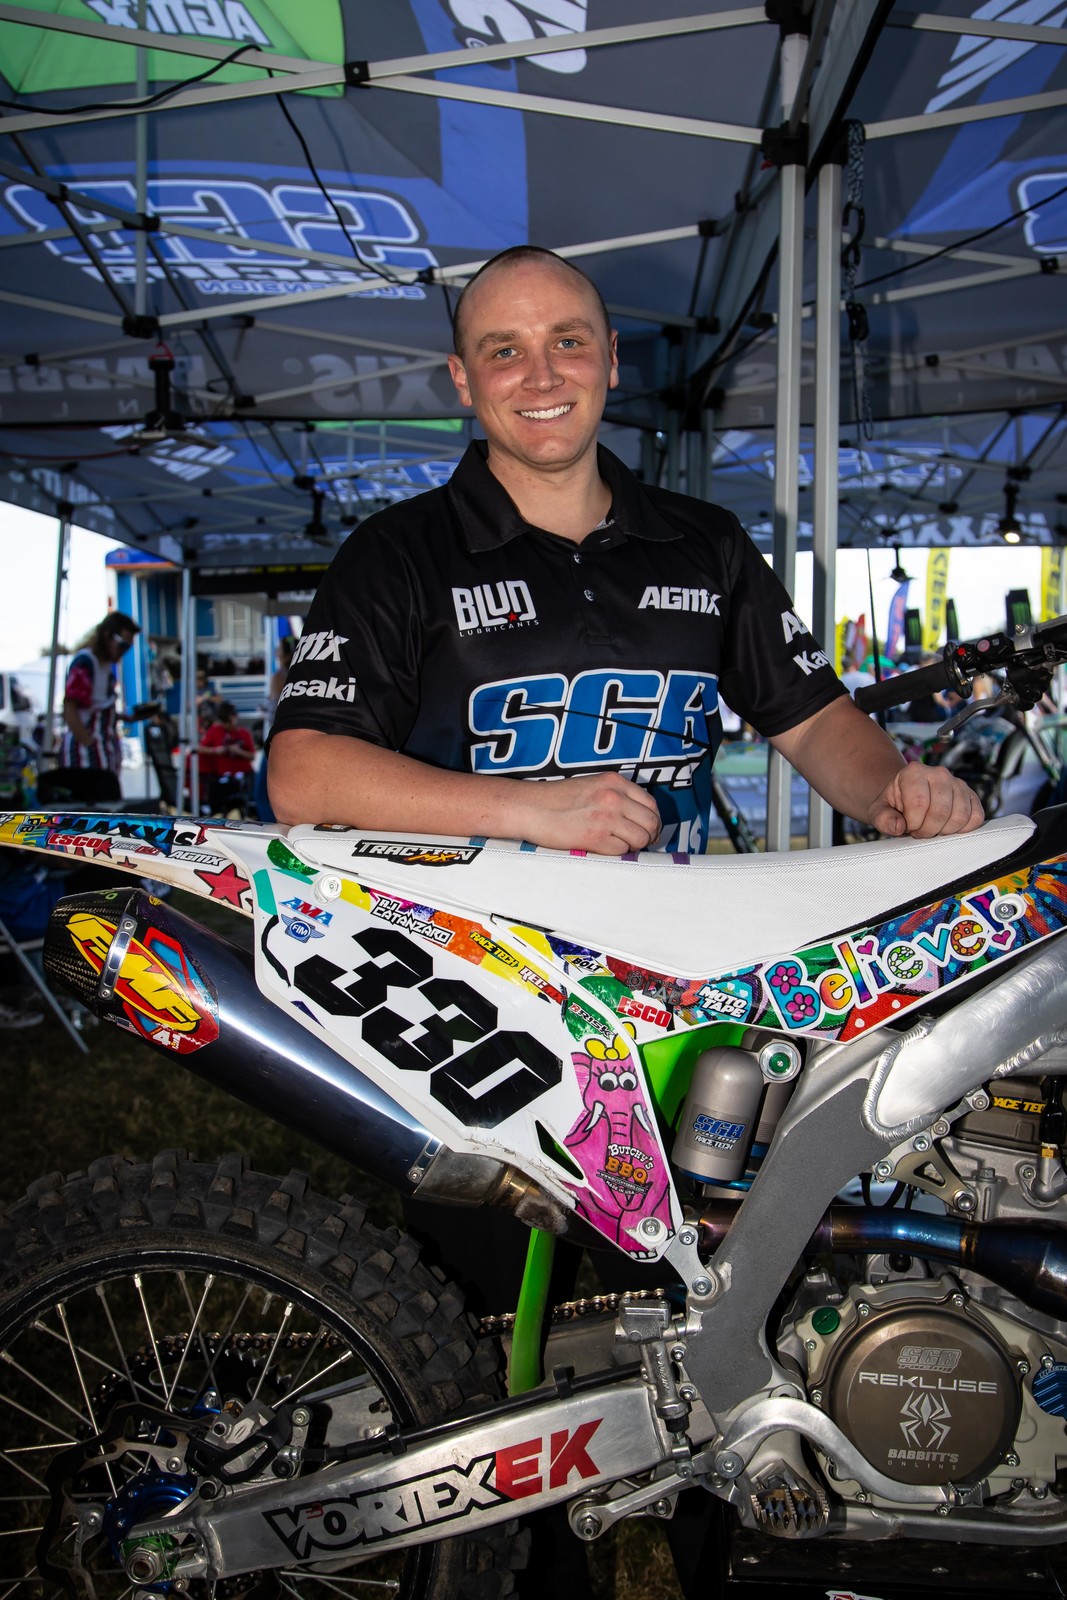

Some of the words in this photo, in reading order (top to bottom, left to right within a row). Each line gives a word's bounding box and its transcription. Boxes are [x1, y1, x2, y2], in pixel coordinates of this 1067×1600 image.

[452, 579, 538, 631] BLUD
[459, 619, 540, 637] LUBRICANTS
[277, 676, 357, 706] asaki
[468, 669, 718, 772] SGB
[48, 833, 103, 849] ESCO
[278, 896, 333, 927] AMA
[292, 922, 309, 937] FIM
[372, 906, 451, 943] CATANZARO
[470, 932, 496, 951] RACE
[493, 947, 519, 968] TECH
[572, 957, 603, 972] BOLT
[642, 981, 683, 1006] LAB
[698, 986, 747, 1009] MOTO
[617, 996, 672, 1028] ESCO
[702, 997, 746, 1018] TAPE
[294, 927, 563, 1129] 330
[694, 1115, 745, 1139] SGB
[605, 1156, 648, 1185] BBQ
[897, 1345, 962, 1368] SGB
[858, 1371, 998, 1394] REKLUSE
[888, 1448, 959, 1463] BABBITT'S
[888, 1460, 957, 1471] ONLINE
[265, 1455, 499, 1557] VORTEX
[496, 1418, 603, 1499] EK
